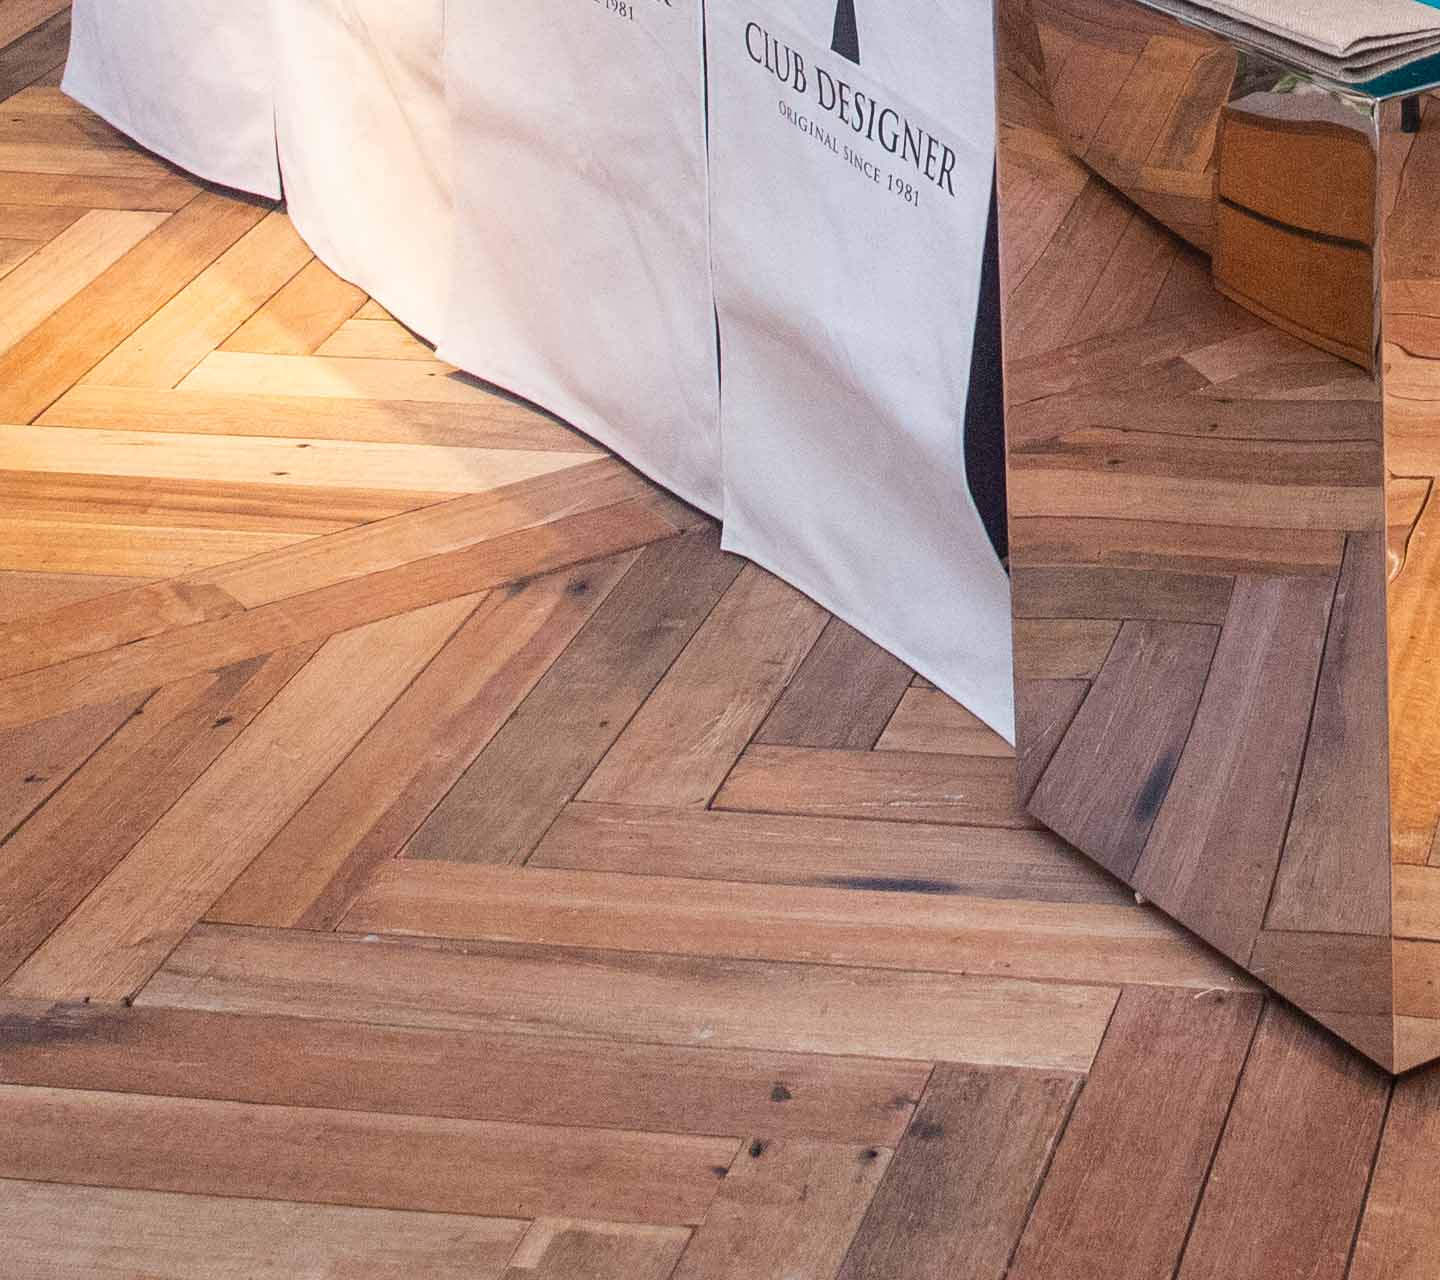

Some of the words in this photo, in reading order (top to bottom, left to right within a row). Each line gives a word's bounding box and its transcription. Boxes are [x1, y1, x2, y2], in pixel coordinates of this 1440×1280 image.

[745, 21, 808, 94] CLUB
[814, 64, 956, 198] DESIGNER
[777, 99, 840, 154] ORIGINAL
[843, 145, 882, 184] SINCE
[887, 173, 920, 208] 1981
